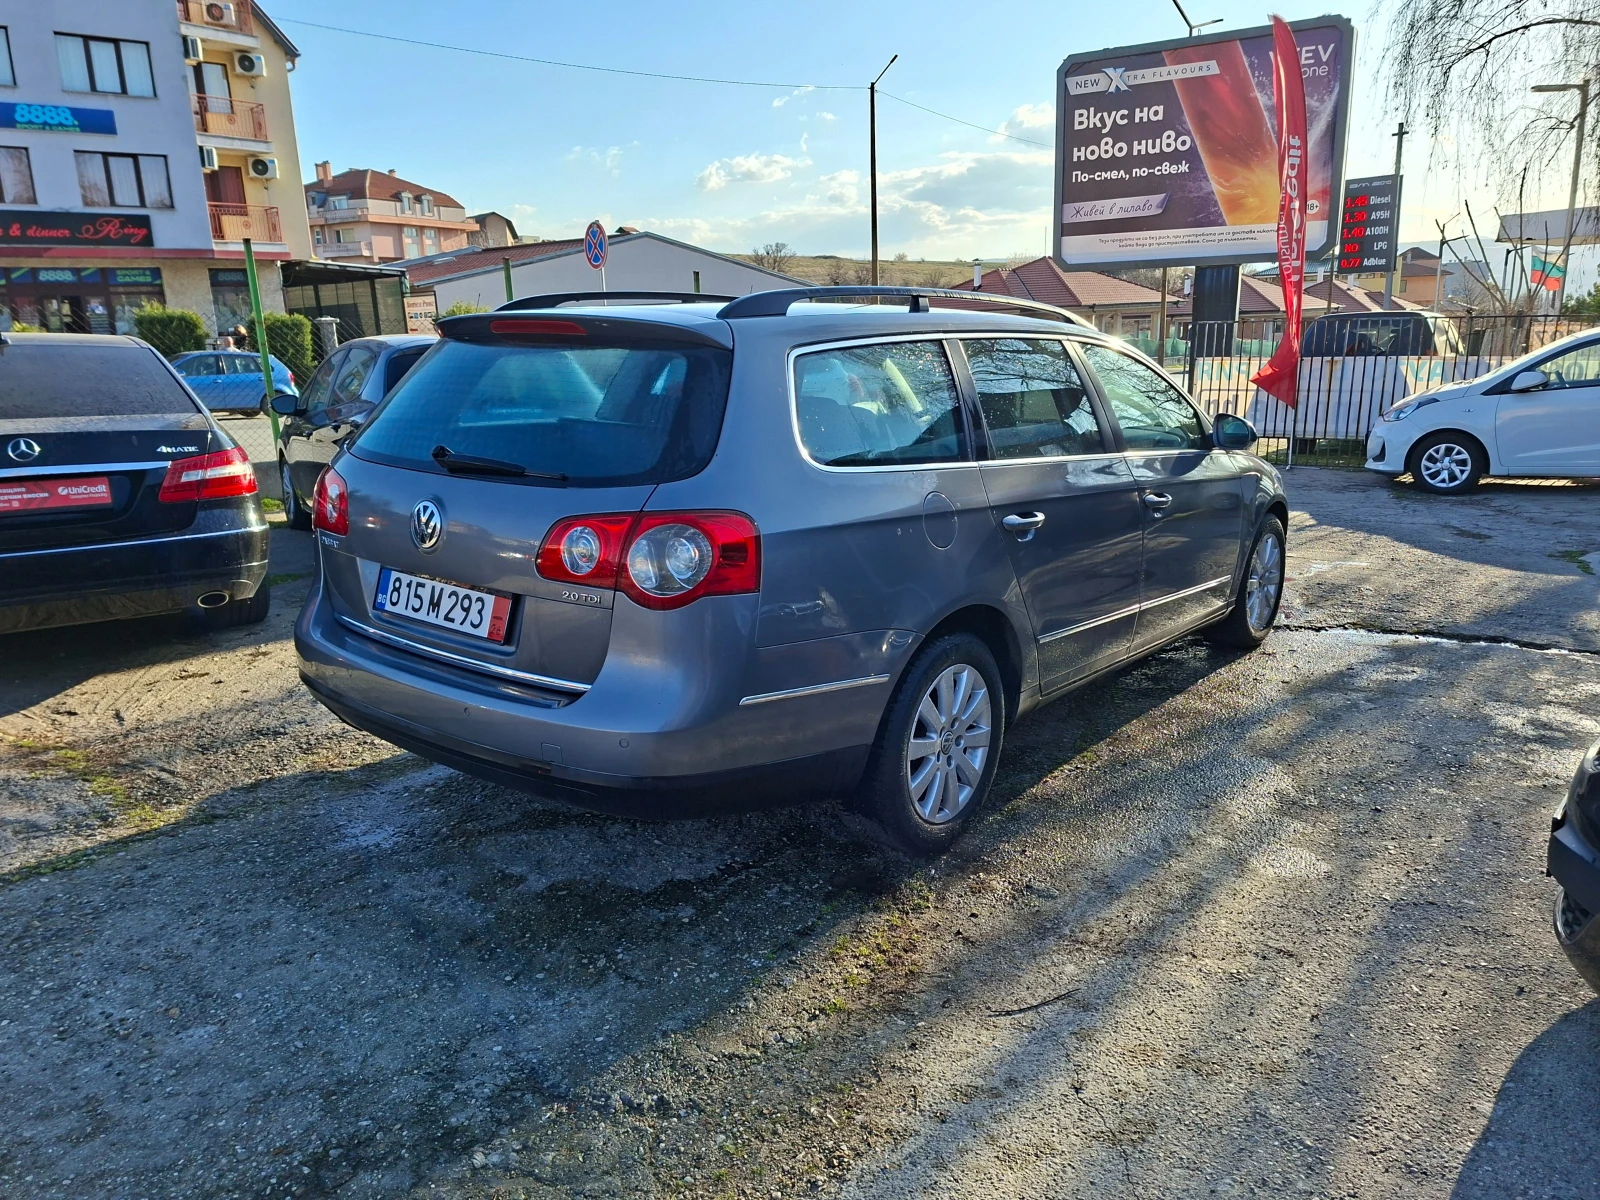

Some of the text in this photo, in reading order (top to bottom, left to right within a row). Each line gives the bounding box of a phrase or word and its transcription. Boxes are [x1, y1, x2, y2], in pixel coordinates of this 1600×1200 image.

[1269, 43, 1335, 64] EV
[1075, 78, 1100, 89] NEW
[1152, 64, 1212, 79] FLAVOURS
[1074, 104, 1163, 134] Вкус на
[1072, 130, 1192, 162] ново ниво
[1072, 160, 1189, 183] По-смел, по-свеж
[1370, 194, 1390, 205] Diesel
[1071, 198, 1153, 219] Живей в лилаво
[1344, 210, 1390, 223] 1.30 A95H
[9, 222, 21, 237] &
[26, 225, 71, 237] dinner
[1343, 226, 1388, 239] 1.40 A100H
[1344, 242, 1388, 252] NO LPG
[1341, 258, 1386, 268] 0.77 Adblue
[68, 484, 106, 494] UniCredit
[378, 594, 387, 604] BG
[390, 576, 485, 629] 815M293
[562, 590, 602, 604] 2.0 TDI
